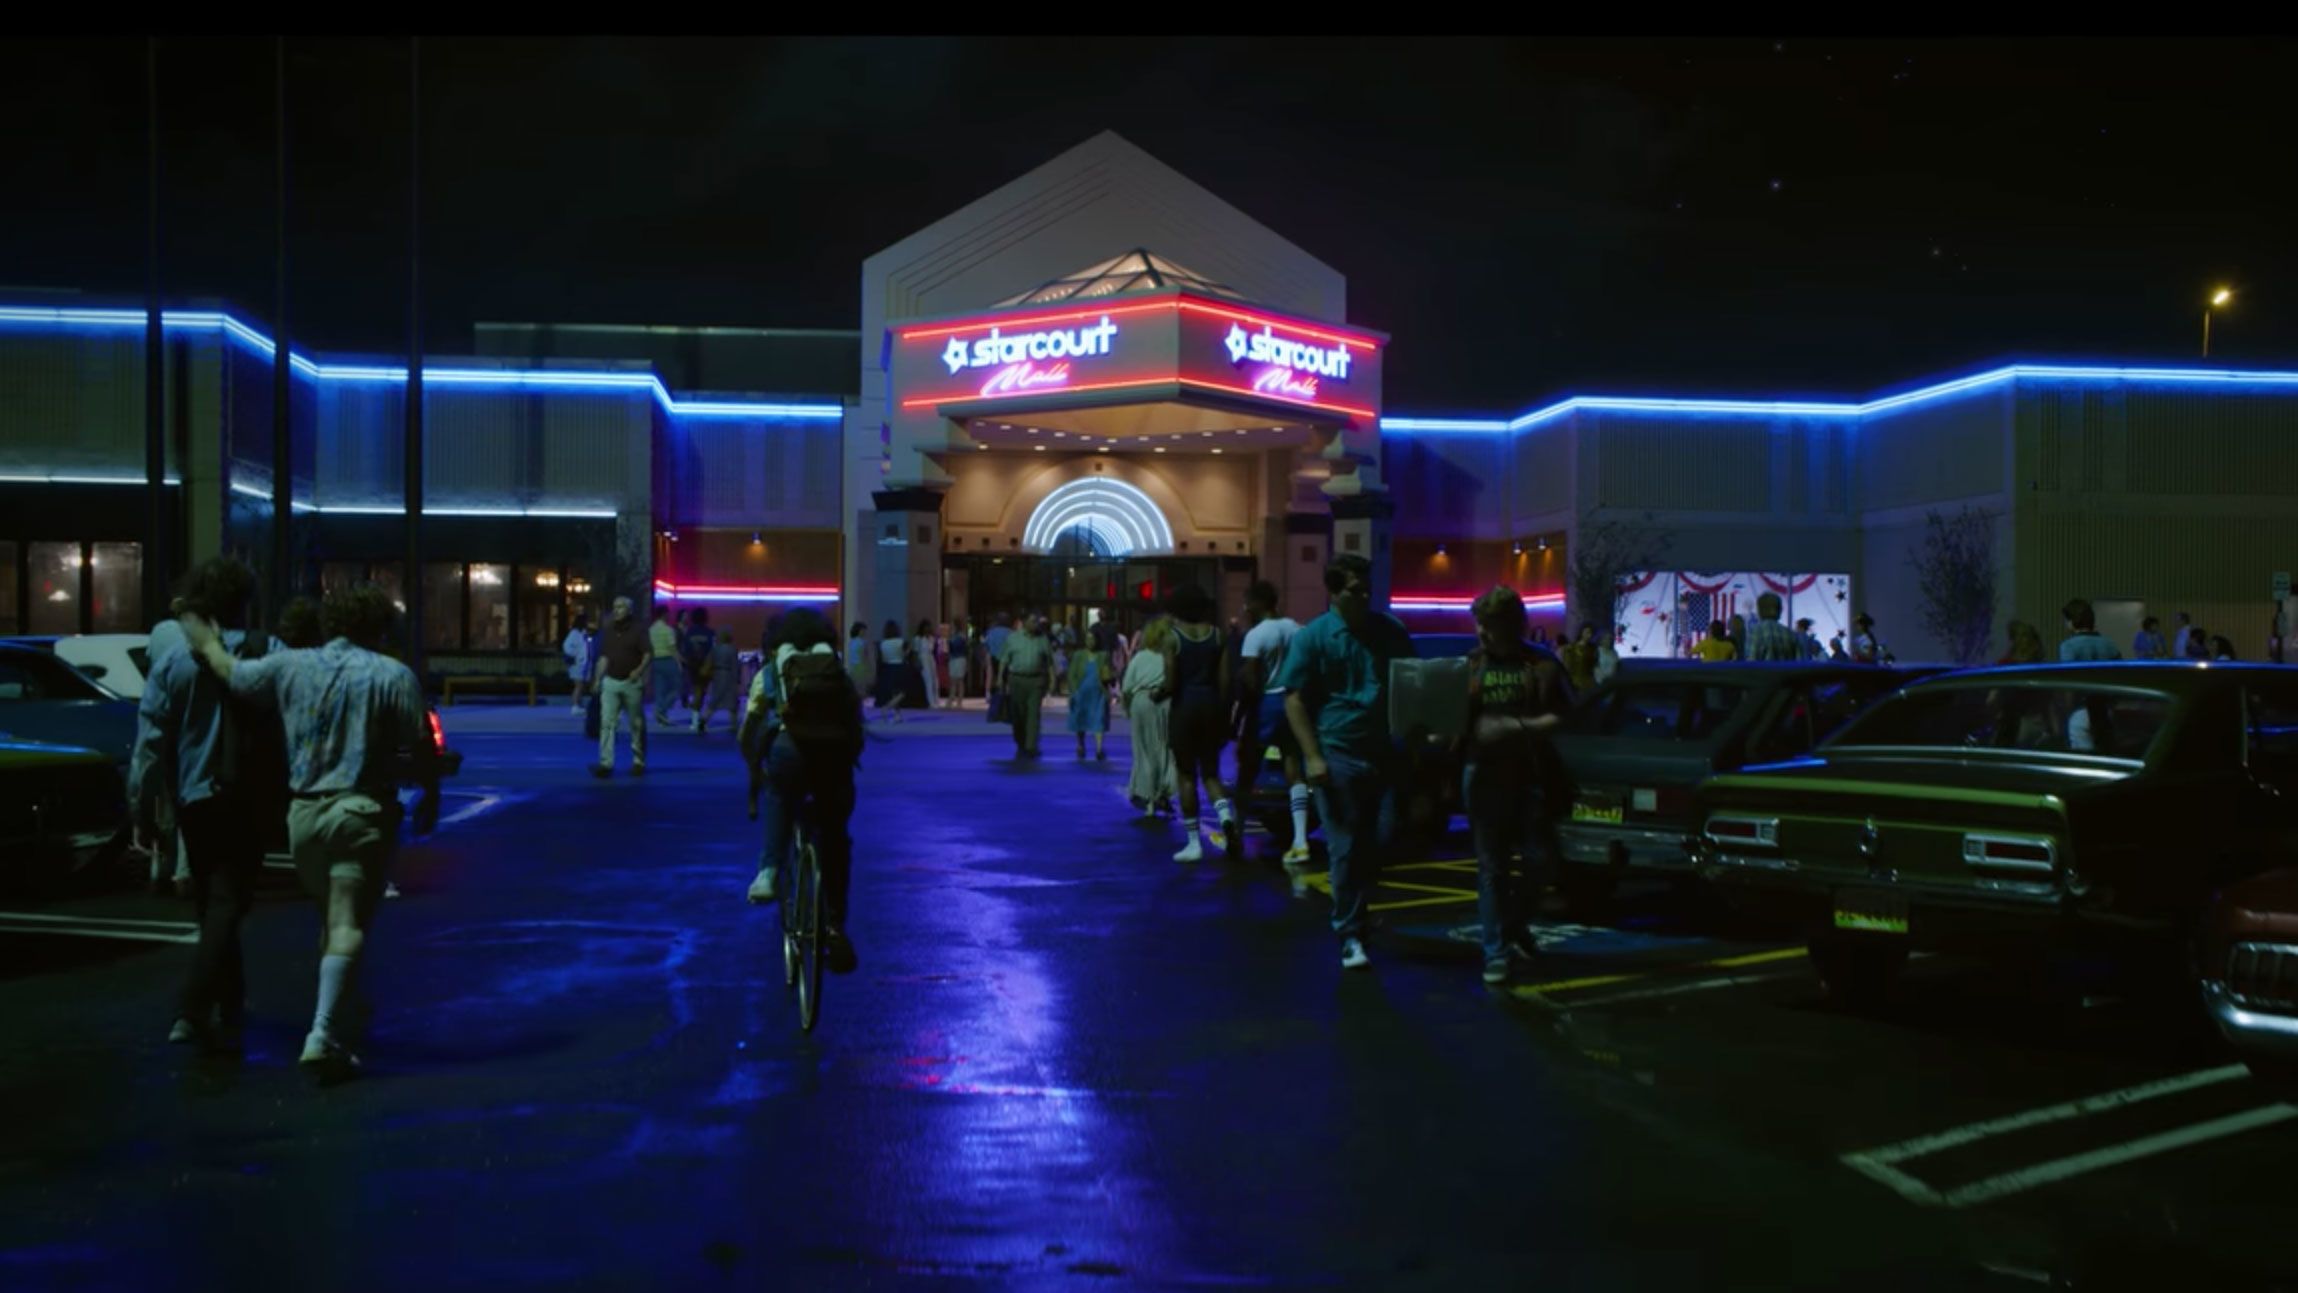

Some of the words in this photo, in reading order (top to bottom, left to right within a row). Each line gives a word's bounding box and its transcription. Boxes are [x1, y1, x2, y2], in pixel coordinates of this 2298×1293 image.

[970, 315, 1117, 367] starcourt
[1248, 324, 1351, 379] starcourt
[980, 362, 1070, 397] Mall
[1253, 367, 1320, 395] Mall
